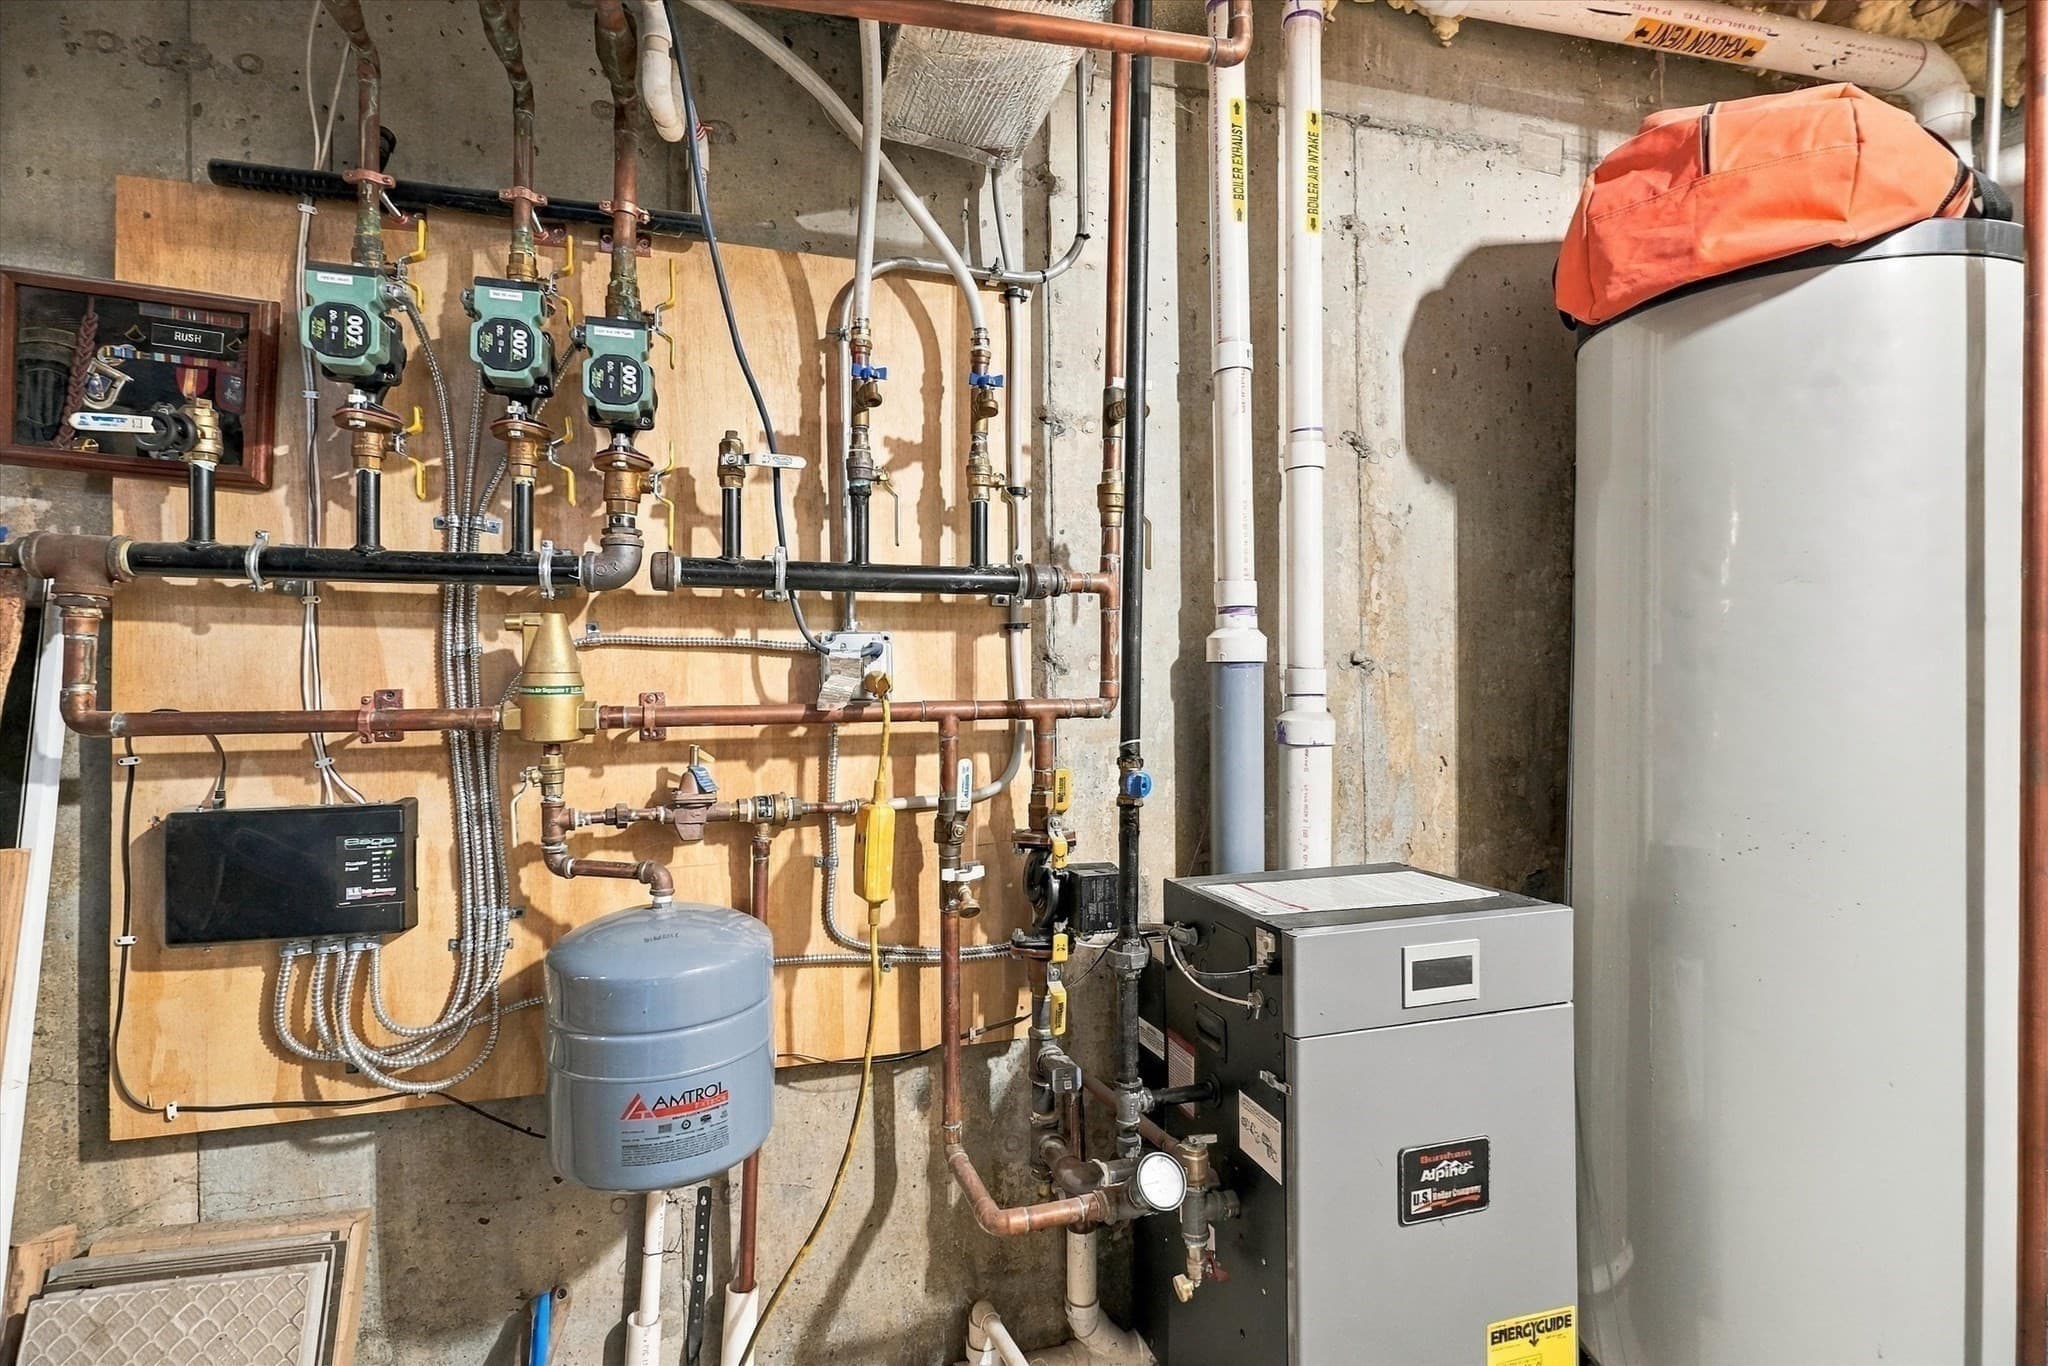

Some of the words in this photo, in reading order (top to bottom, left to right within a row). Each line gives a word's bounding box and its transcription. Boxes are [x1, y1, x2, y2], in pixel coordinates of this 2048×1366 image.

[1642, 23, 1693, 50] VENT
[1683, 31, 1748, 59] RADON
[1231, 123, 1244, 165] EXHAUST
[1307, 131, 1320, 163] INTAKE
[1232, 166, 1245, 200] BOILER
[1307, 164, 1320, 181] AIR
[1307, 181, 1320, 215] BOILER
[174, 331, 202, 344] RUSH
[652, 1081, 722, 1112] AMTROL
[1420, 1161, 1470, 1182] Alpine
